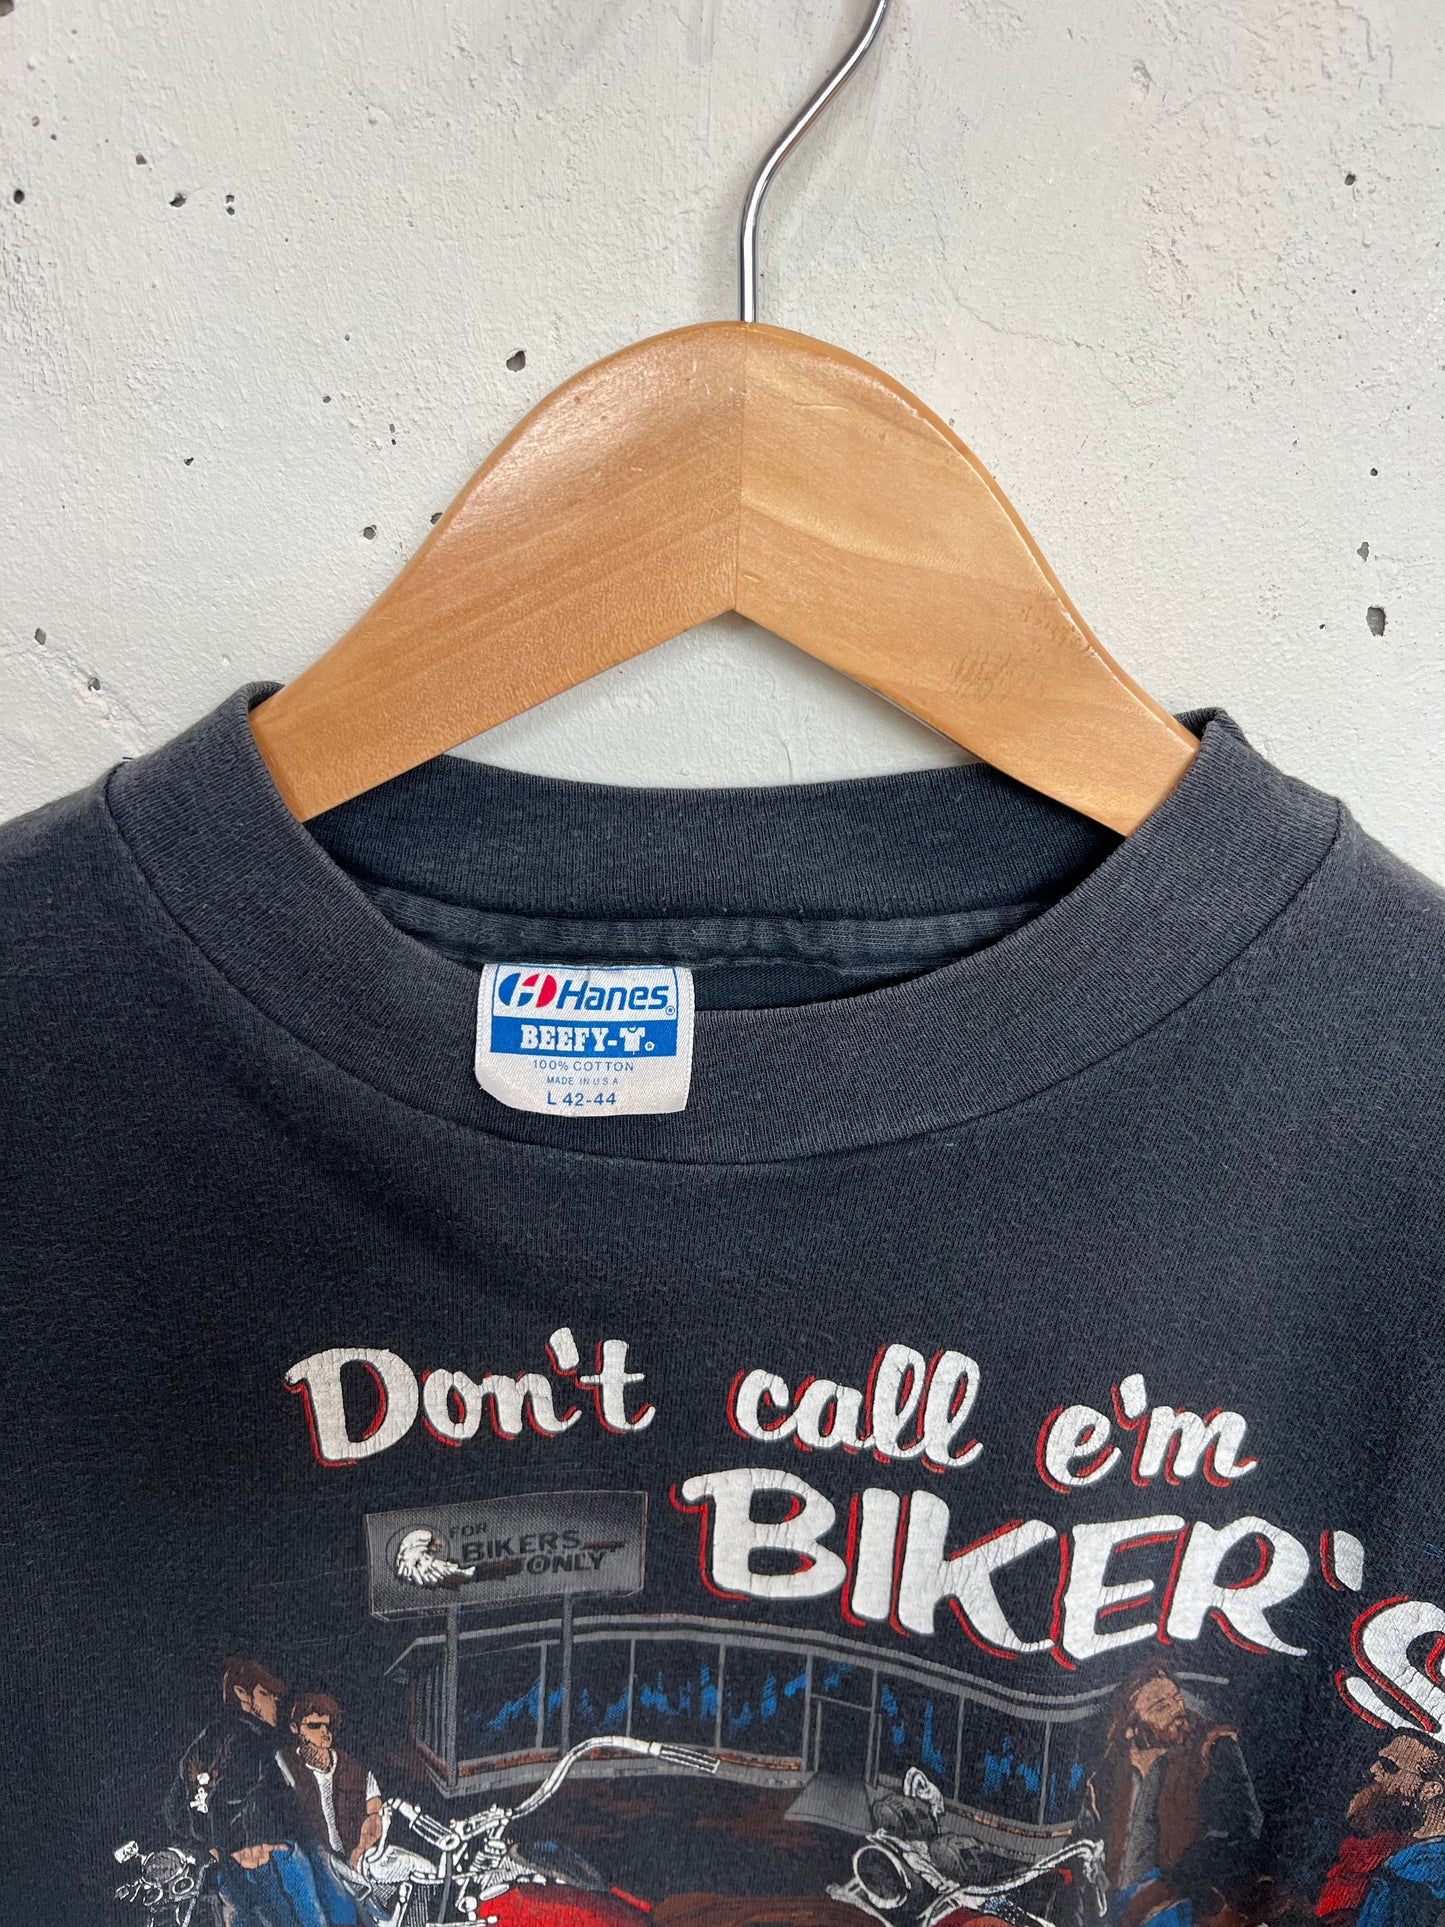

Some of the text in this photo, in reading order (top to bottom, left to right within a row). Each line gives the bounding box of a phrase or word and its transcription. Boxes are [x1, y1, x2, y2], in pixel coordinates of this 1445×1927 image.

[556, 980, 669, 1010] Hanes
[533, 1059, 634, 1071] 100% COTTON
[546, 1076, 574, 1085] MADE
[579, 1076, 590, 1085] IN
[547, 1091, 617, 1106] L 42-44
[284, 1327, 1258, 1493] Don't call e'm
[461, 1529, 583, 1563] BIKERS
[526, 1551, 607, 1575] ONLY
